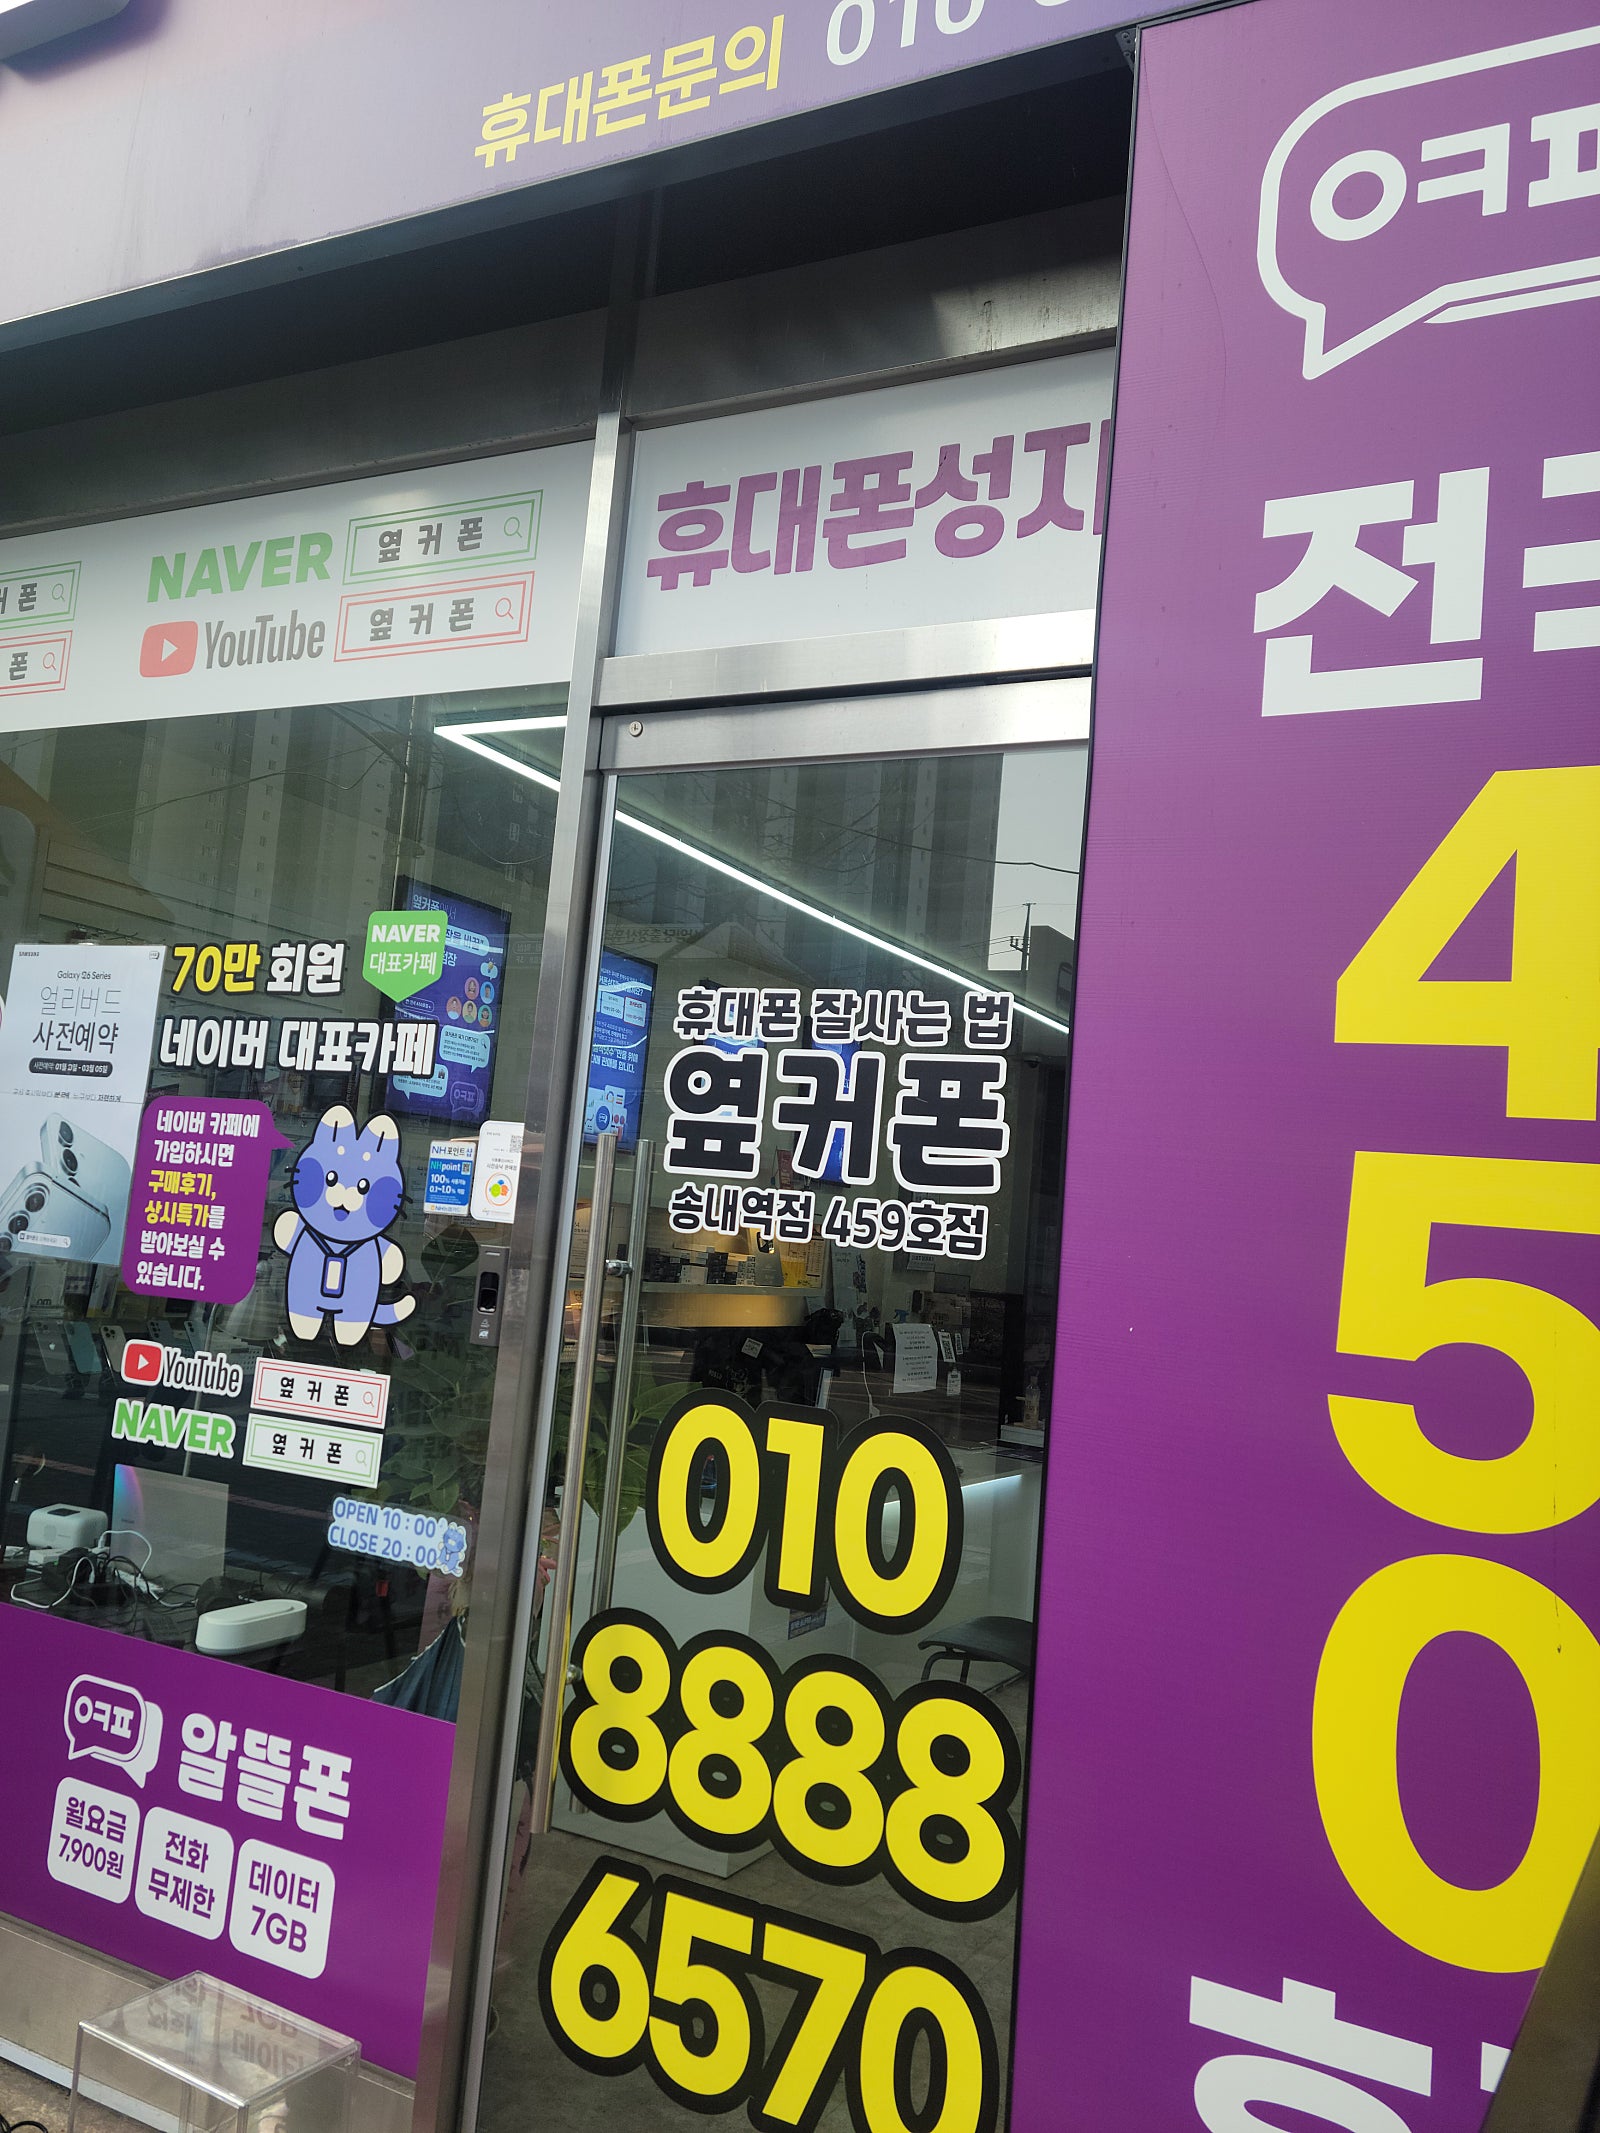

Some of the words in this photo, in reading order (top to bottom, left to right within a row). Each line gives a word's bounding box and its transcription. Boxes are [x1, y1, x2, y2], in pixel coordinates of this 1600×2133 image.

[473, 15, 785, 169] 휴대폰문의
[147, 532, 332, 603] NAVER
[205, 609, 326, 669] YouTube
[371, 924, 440, 944] NAVER
[57, 970, 80, 982] Galaxy
[92, 972, 112, 980] Series
[172, 943, 261, 993] 70만
[266, 942, 345, 993] 회원
[369, 951, 437, 976] 대표카페
[40, 985, 122, 1017] 얼리버드
[675, 989, 800, 1041] 휴대폰
[812, 991, 951, 1045] 잘사는
[966, 993, 1011, 1047] 법
[32, 1020, 119, 1054] 사전예약
[160, 1018, 270, 1070] 네이버
[278, 1020, 436, 1075] 대표카페
[156, 1110, 206, 1134] 네이버
[209, 1112, 261, 1138] 카페에
[154, 1140, 235, 1167] 가입하시면
[430, 1160, 461, 1172] NHpoint
[148, 1169, 216, 1201] 구매후기,
[144, 1200, 226, 1230] 상시특가를
[671, 1185, 815, 1241] 송내역점
[823, 1196, 988, 1258] 459호점
[140, 1230, 205, 1259] 받아보실
[208, 1237, 225, 1261] 수
[136, 1260, 205, 1291] 있습니다.
[165, 1347, 240, 1393] YouTube
[115, 1402, 233, 1454] NAVER
[334, 1500, 379, 1526] OPEN
[658, 1403, 949, 1618] 010
[330, 1525, 379, 1553] CLOSE
[178, 1713, 353, 1841] 알뜰폰
[570, 1622, 1006, 1903] 8888
[65, 1796, 127, 1844] 월요금
[58, 1832, 124, 1880] 7,900원
[165, 1830, 209, 1874] 전화
[148, 1868, 215, 1920] 무제한
[248, 1860, 320, 1914] 데이터
[250, 1904, 308, 1953] 7GB
[551, 1872, 984, 2133] 6570
